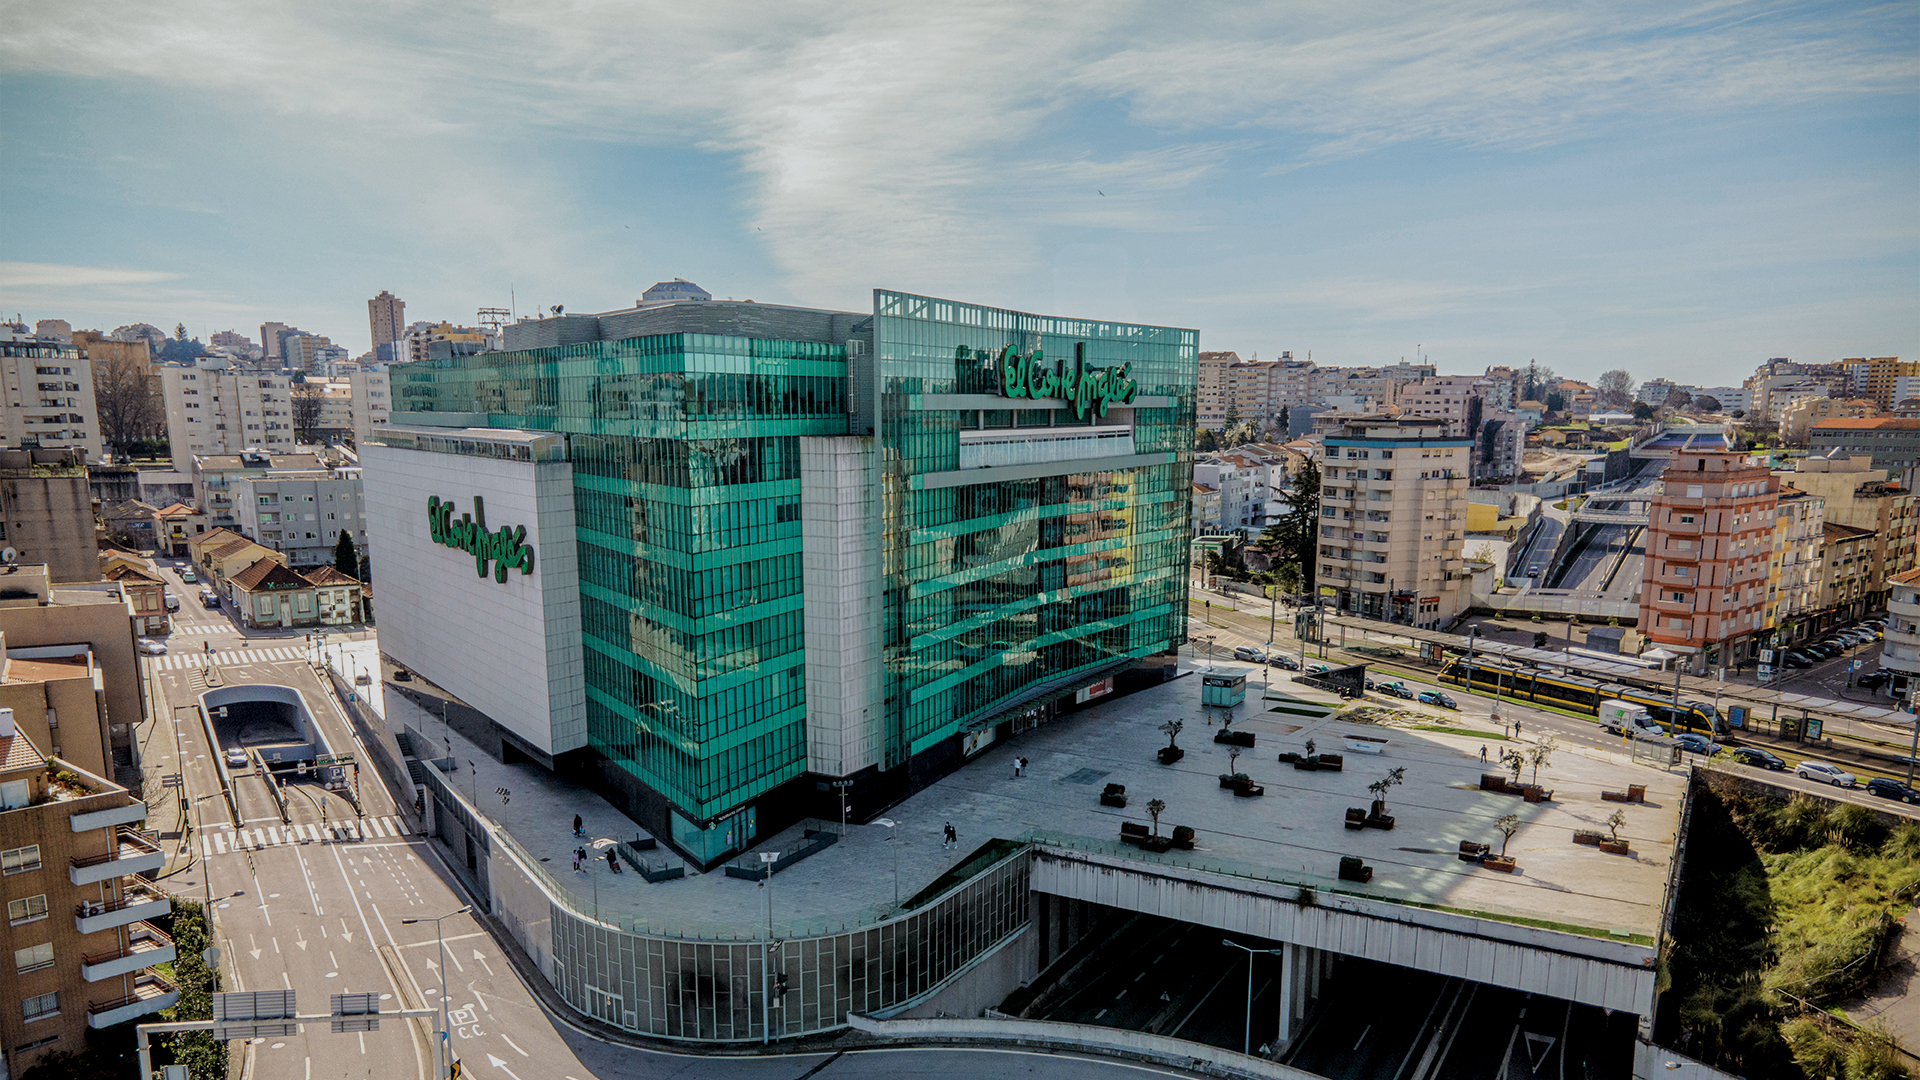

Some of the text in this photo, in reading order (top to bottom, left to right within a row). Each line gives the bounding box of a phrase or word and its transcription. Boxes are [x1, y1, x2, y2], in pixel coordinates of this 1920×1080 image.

[1001, 342, 1137, 420] El Corte Inglés
[428, 495, 534, 583] El Corte Inglés
[454, 1012, 467, 1023] P
